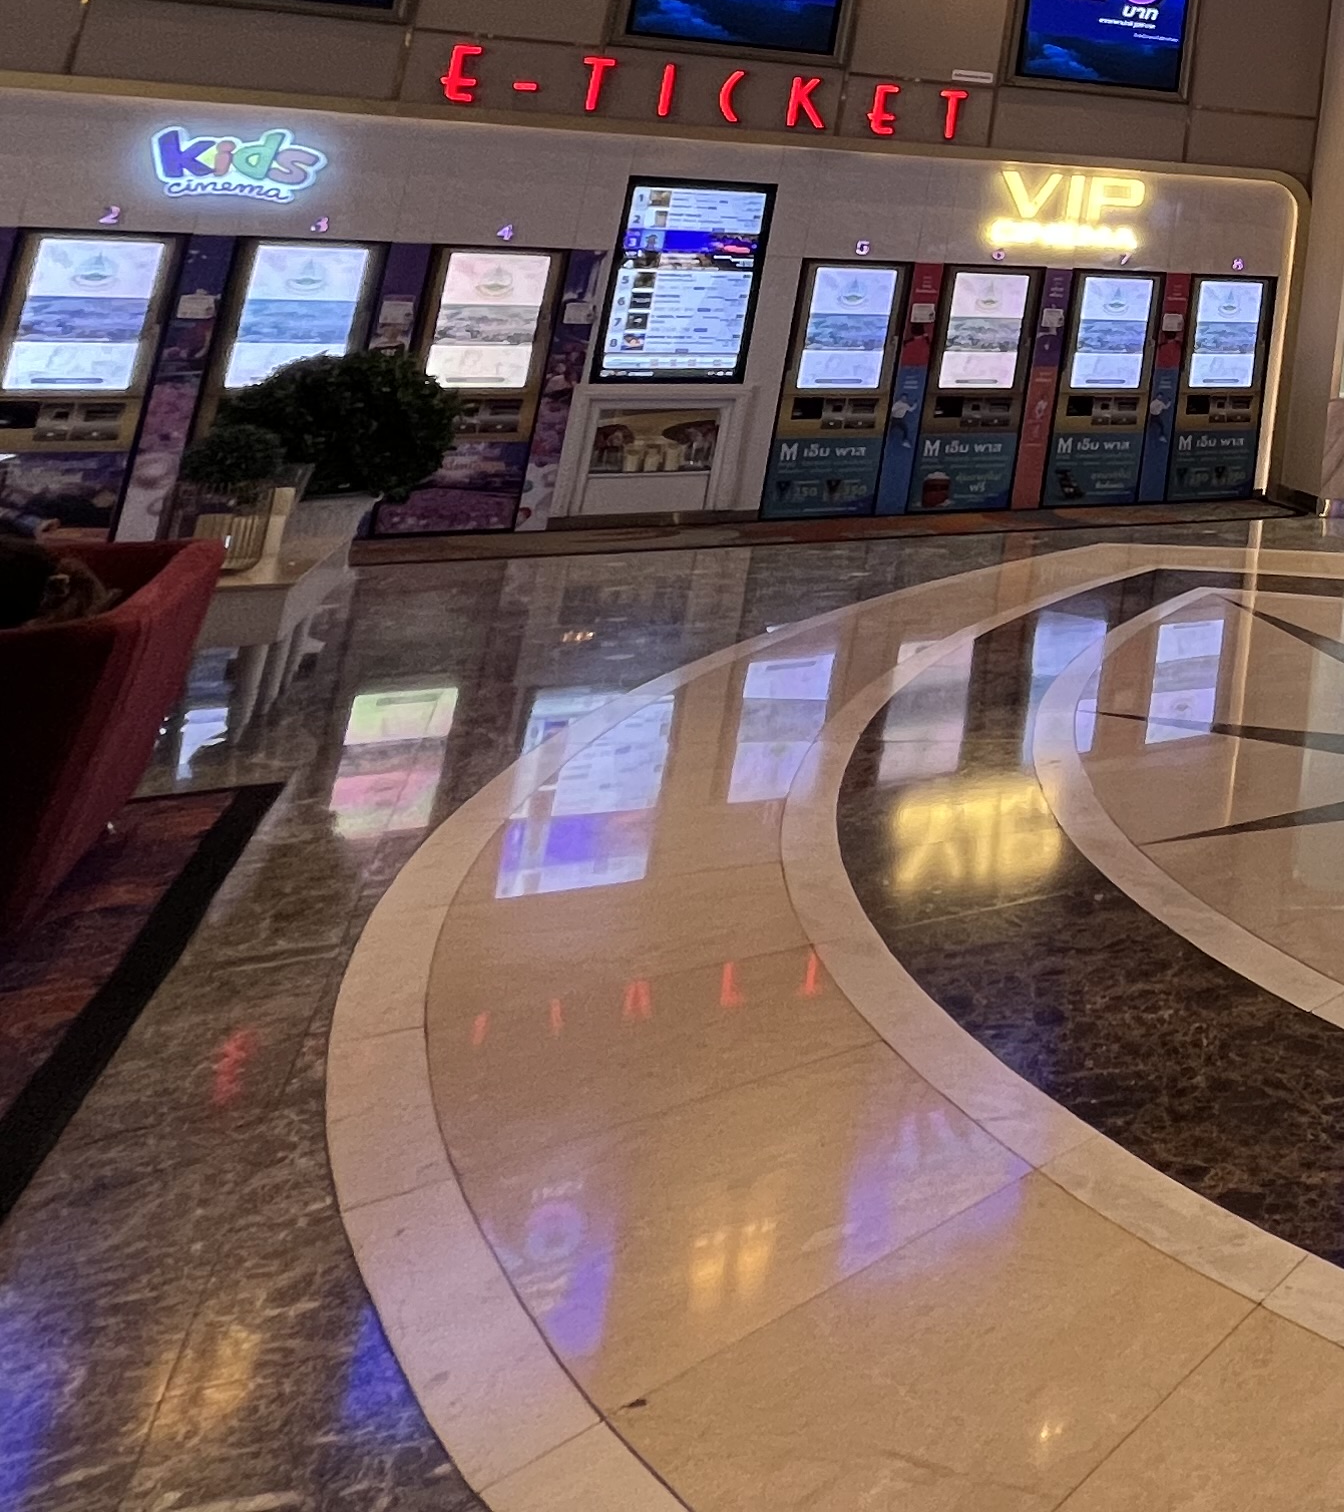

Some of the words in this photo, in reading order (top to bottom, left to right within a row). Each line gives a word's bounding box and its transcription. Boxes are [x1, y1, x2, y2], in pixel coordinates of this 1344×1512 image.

[1122, 5, 1160, 21] บาท
[168, 179, 289, 200] cinema
[1002, 170, 1146, 223] VIP
[98, 205, 121, 226] 2
[310, 216, 330, 234] 3
[497, 224, 515, 242] 4
[855, 240, 871, 255] 5
[1232, 257, 1244, 271] 8
